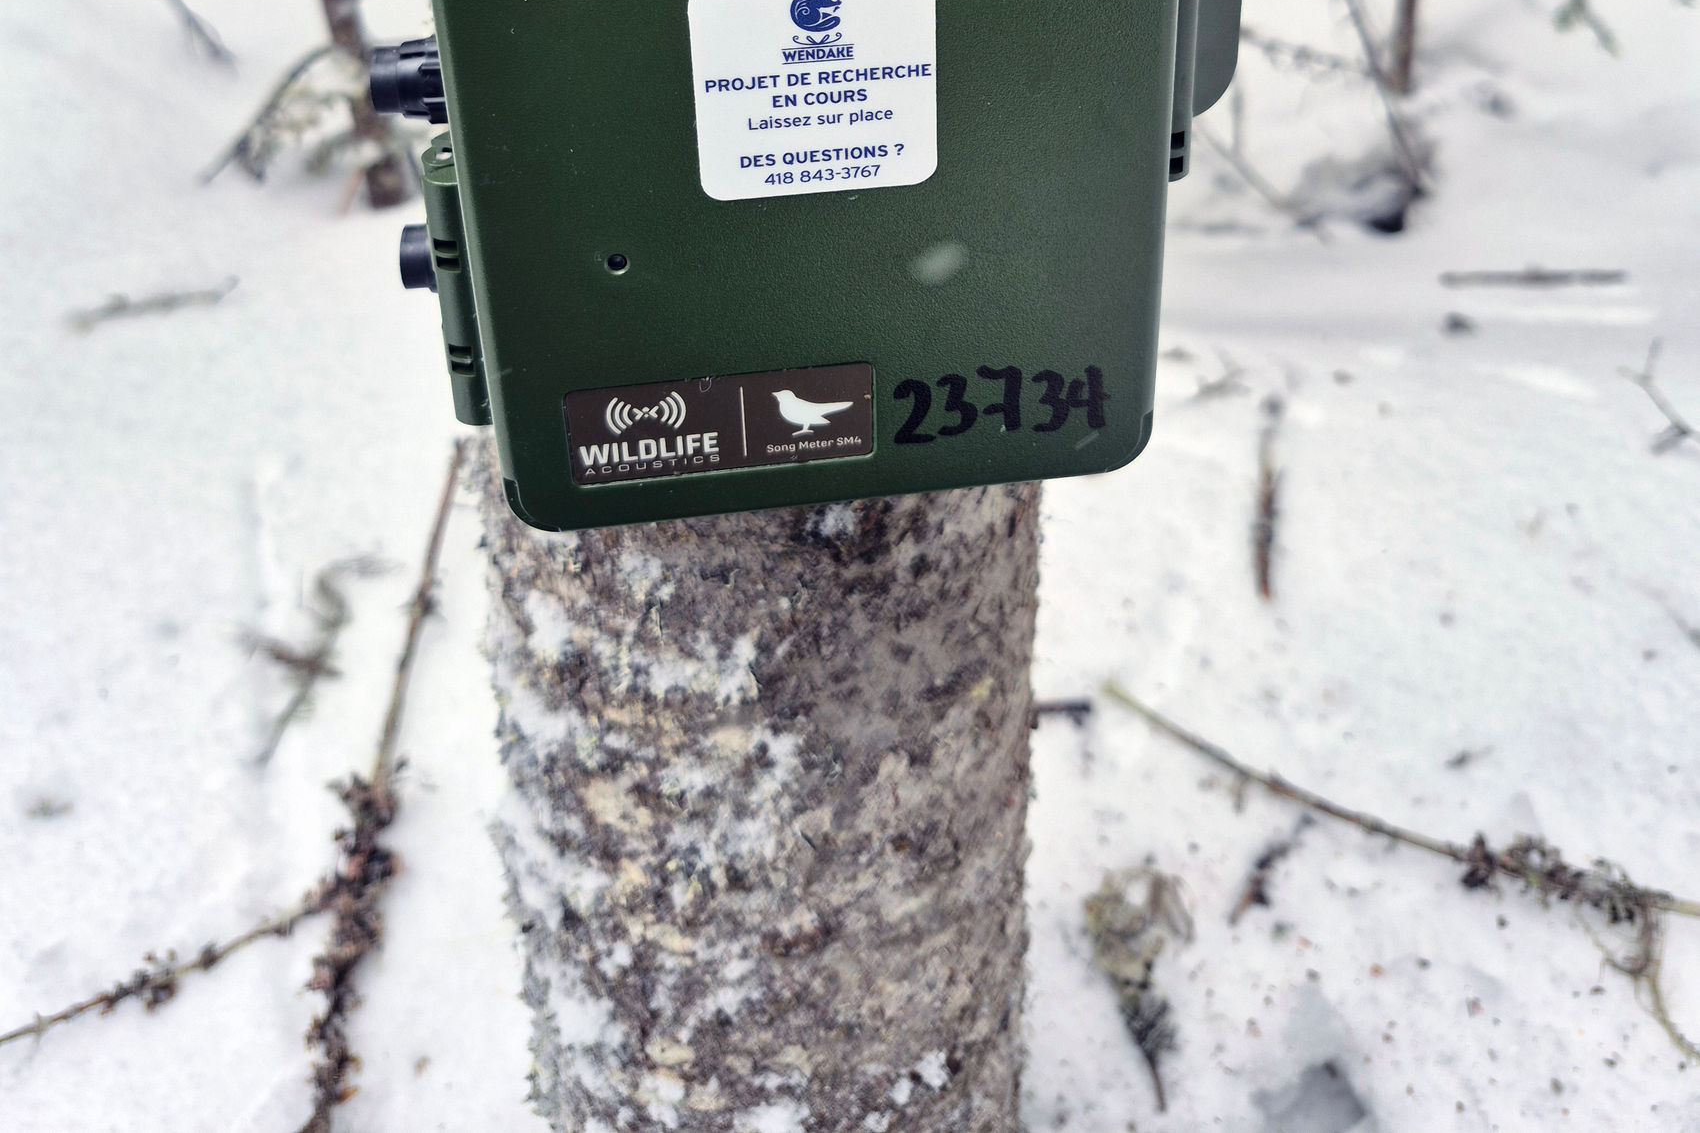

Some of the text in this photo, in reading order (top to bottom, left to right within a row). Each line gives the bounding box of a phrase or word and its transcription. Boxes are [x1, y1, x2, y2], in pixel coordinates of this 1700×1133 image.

[782, 46, 854, 63] WENDAKE
[704, 63, 932, 93] PROJET DE RECHERCHE
[772, 88, 868, 108] EN COURS
[748, 106, 894, 131] Laissez sur place
[740, 143, 905, 169] DES QUESTIONS ?
[764, 165, 881, 186] 418 843-3767
[893, 365, 1110, 445] 23734
[578, 431, 720, 466] WILDLIFE
[766, 436, 862, 454] Song Meter SM4
[584, 454, 721, 476] ACOUSTICS
